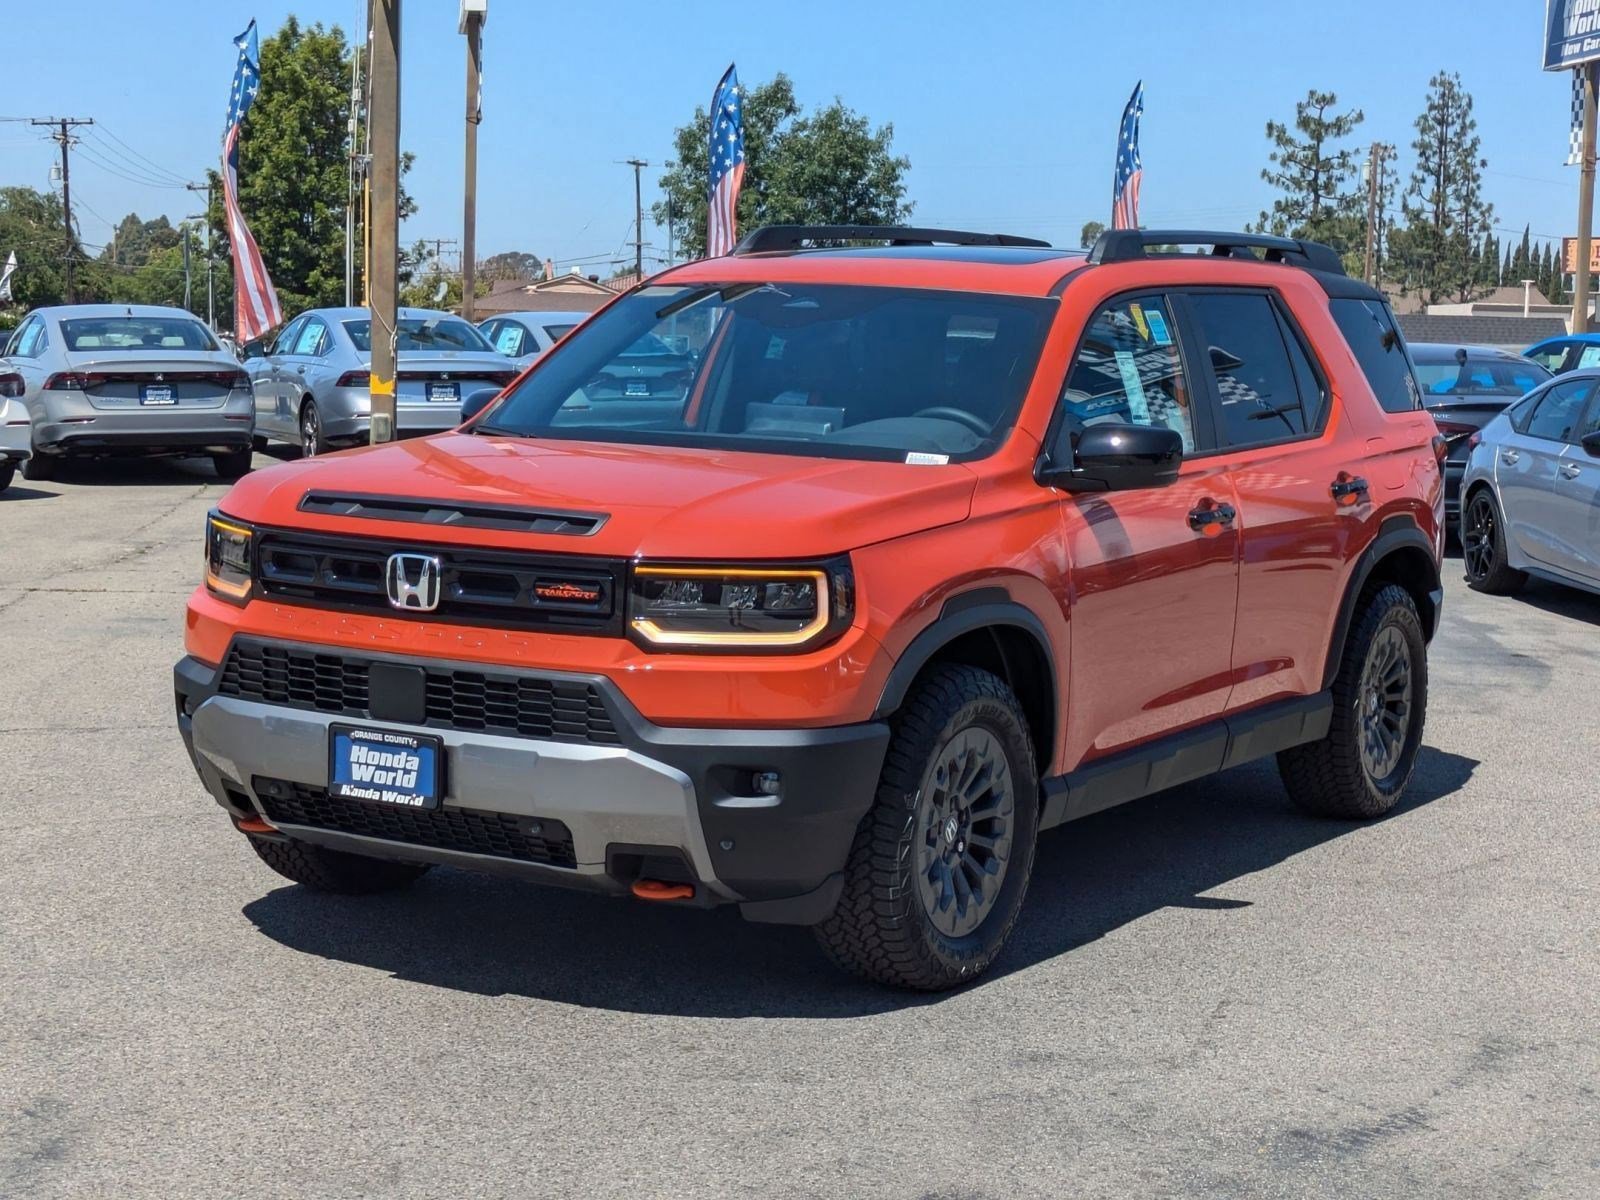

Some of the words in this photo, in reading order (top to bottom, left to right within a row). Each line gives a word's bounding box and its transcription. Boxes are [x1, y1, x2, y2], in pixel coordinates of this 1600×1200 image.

[1561, 43, 1581, 57] New
[535, 588, 598, 599] TRAILSPORT
[354, 731, 383, 741] ORANGE
[384, 735, 413, 745] COUNTY
[350, 745, 419, 770] Honda
[352, 763, 417, 788] World
